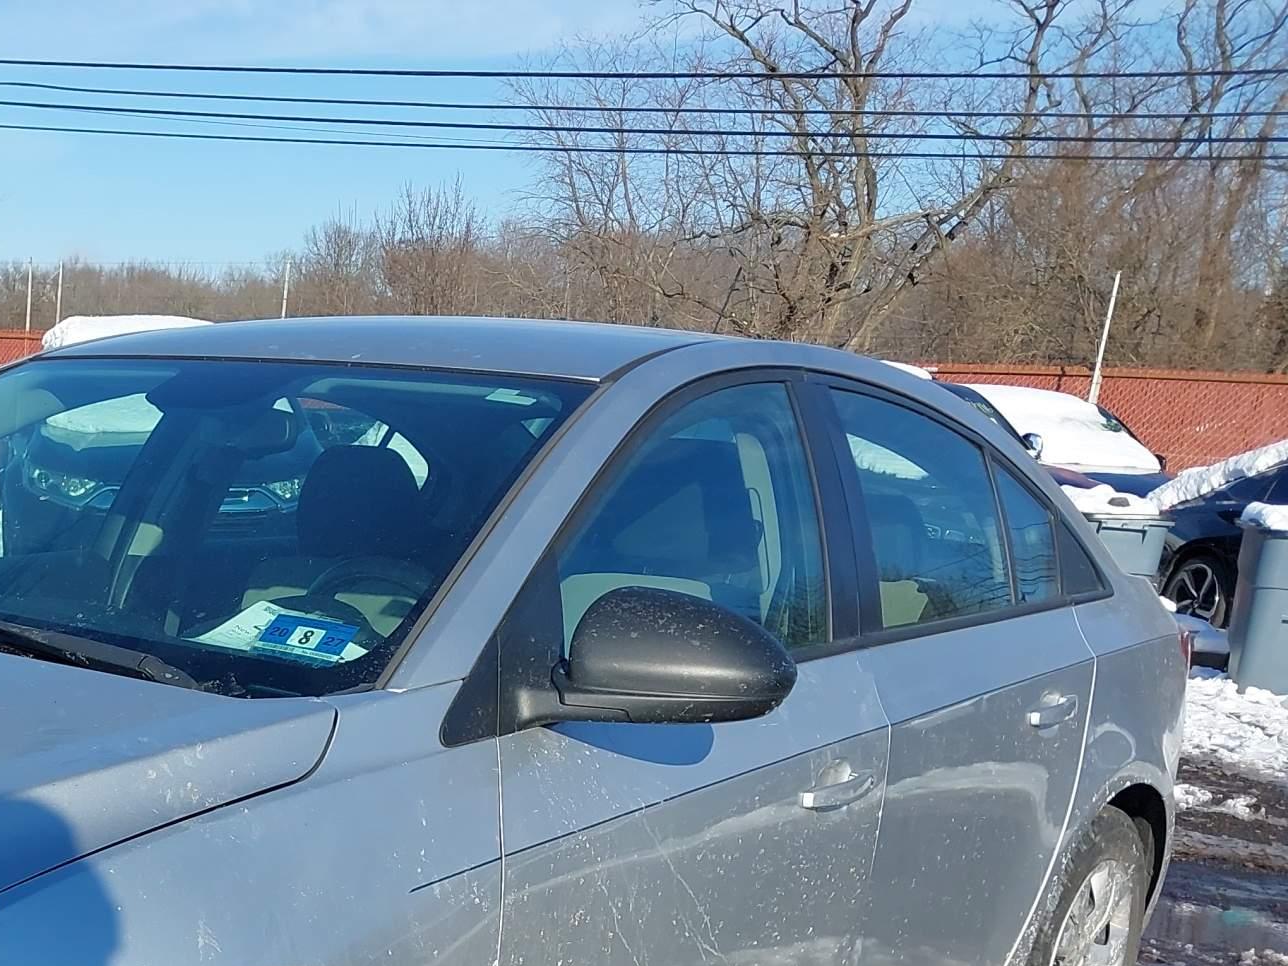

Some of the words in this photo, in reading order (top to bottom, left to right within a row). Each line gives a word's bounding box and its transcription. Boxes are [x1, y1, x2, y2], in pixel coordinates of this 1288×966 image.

[269, 626, 290, 638] 20
[297, 630, 315, 645] 8
[323, 636, 345, 648] 27
